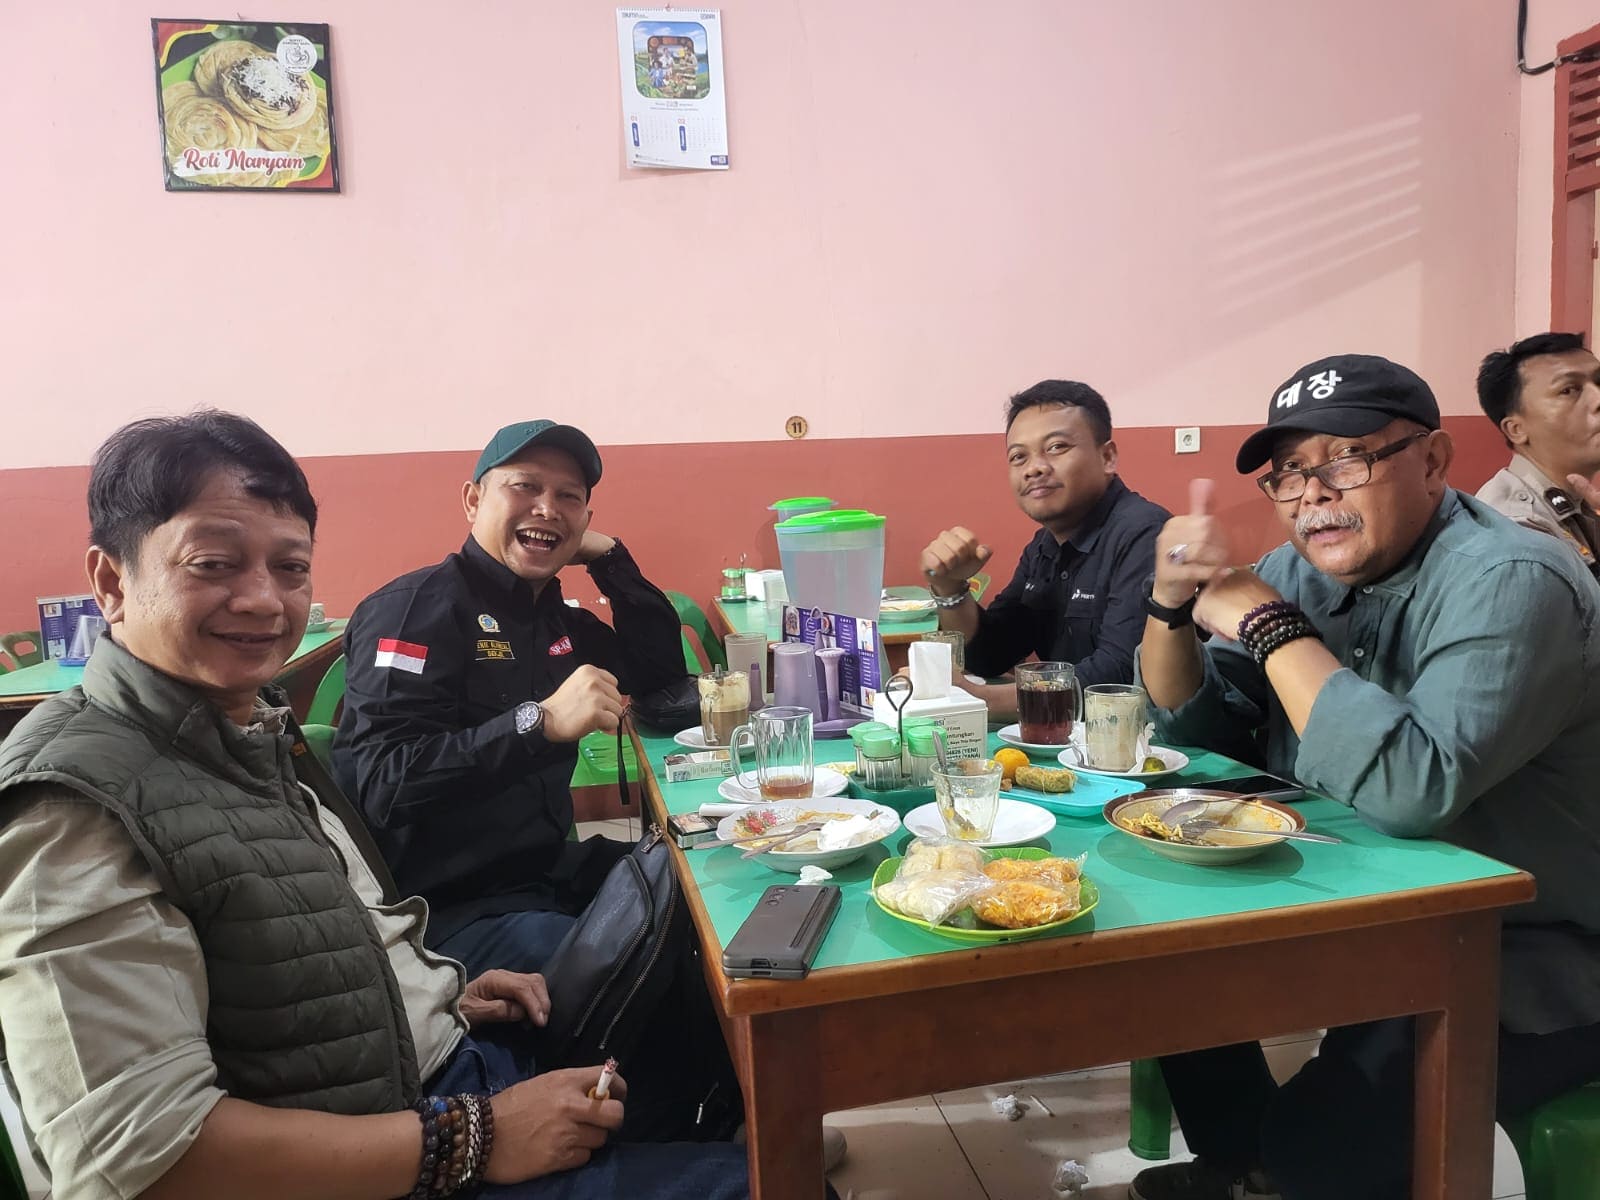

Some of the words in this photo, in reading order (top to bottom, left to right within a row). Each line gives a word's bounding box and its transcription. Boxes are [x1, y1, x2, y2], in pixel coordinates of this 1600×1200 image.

[183, 148, 221, 171] Roti
[224, 148, 305, 176] Maryam
[1277, 370, 1343, 409] 대장
[791, 421, 802, 434] 11
